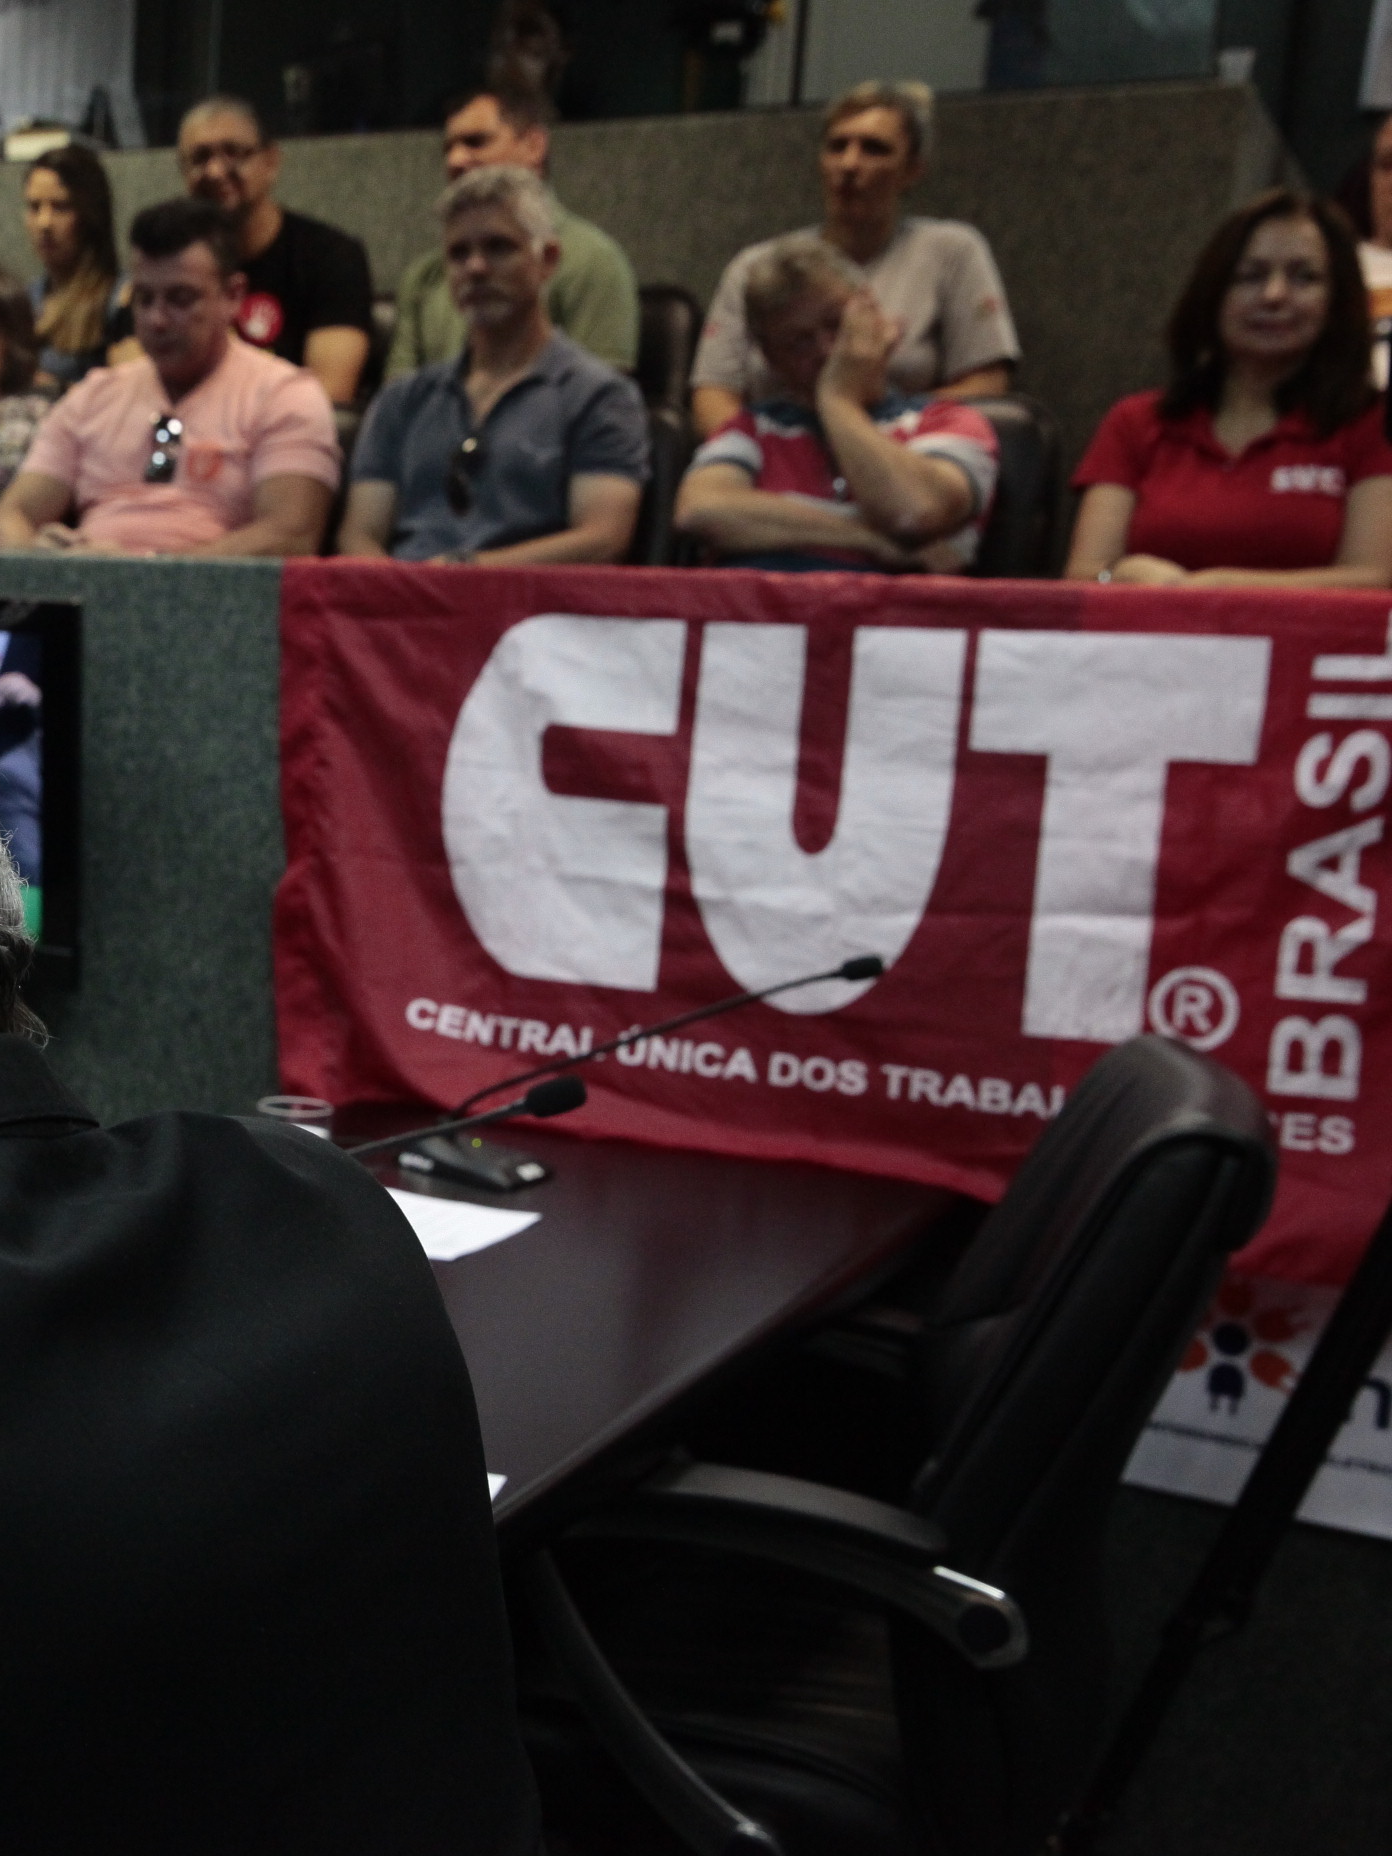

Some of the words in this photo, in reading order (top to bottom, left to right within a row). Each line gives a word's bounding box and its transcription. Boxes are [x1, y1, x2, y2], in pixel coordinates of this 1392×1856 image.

[441, 612, 1272, 1043] CUT
[1265, 606, 1392, 1101] BRASIL
[615, 1004, 757, 1084] ÚNICA
[767, 1051, 868, 1097] DOS
